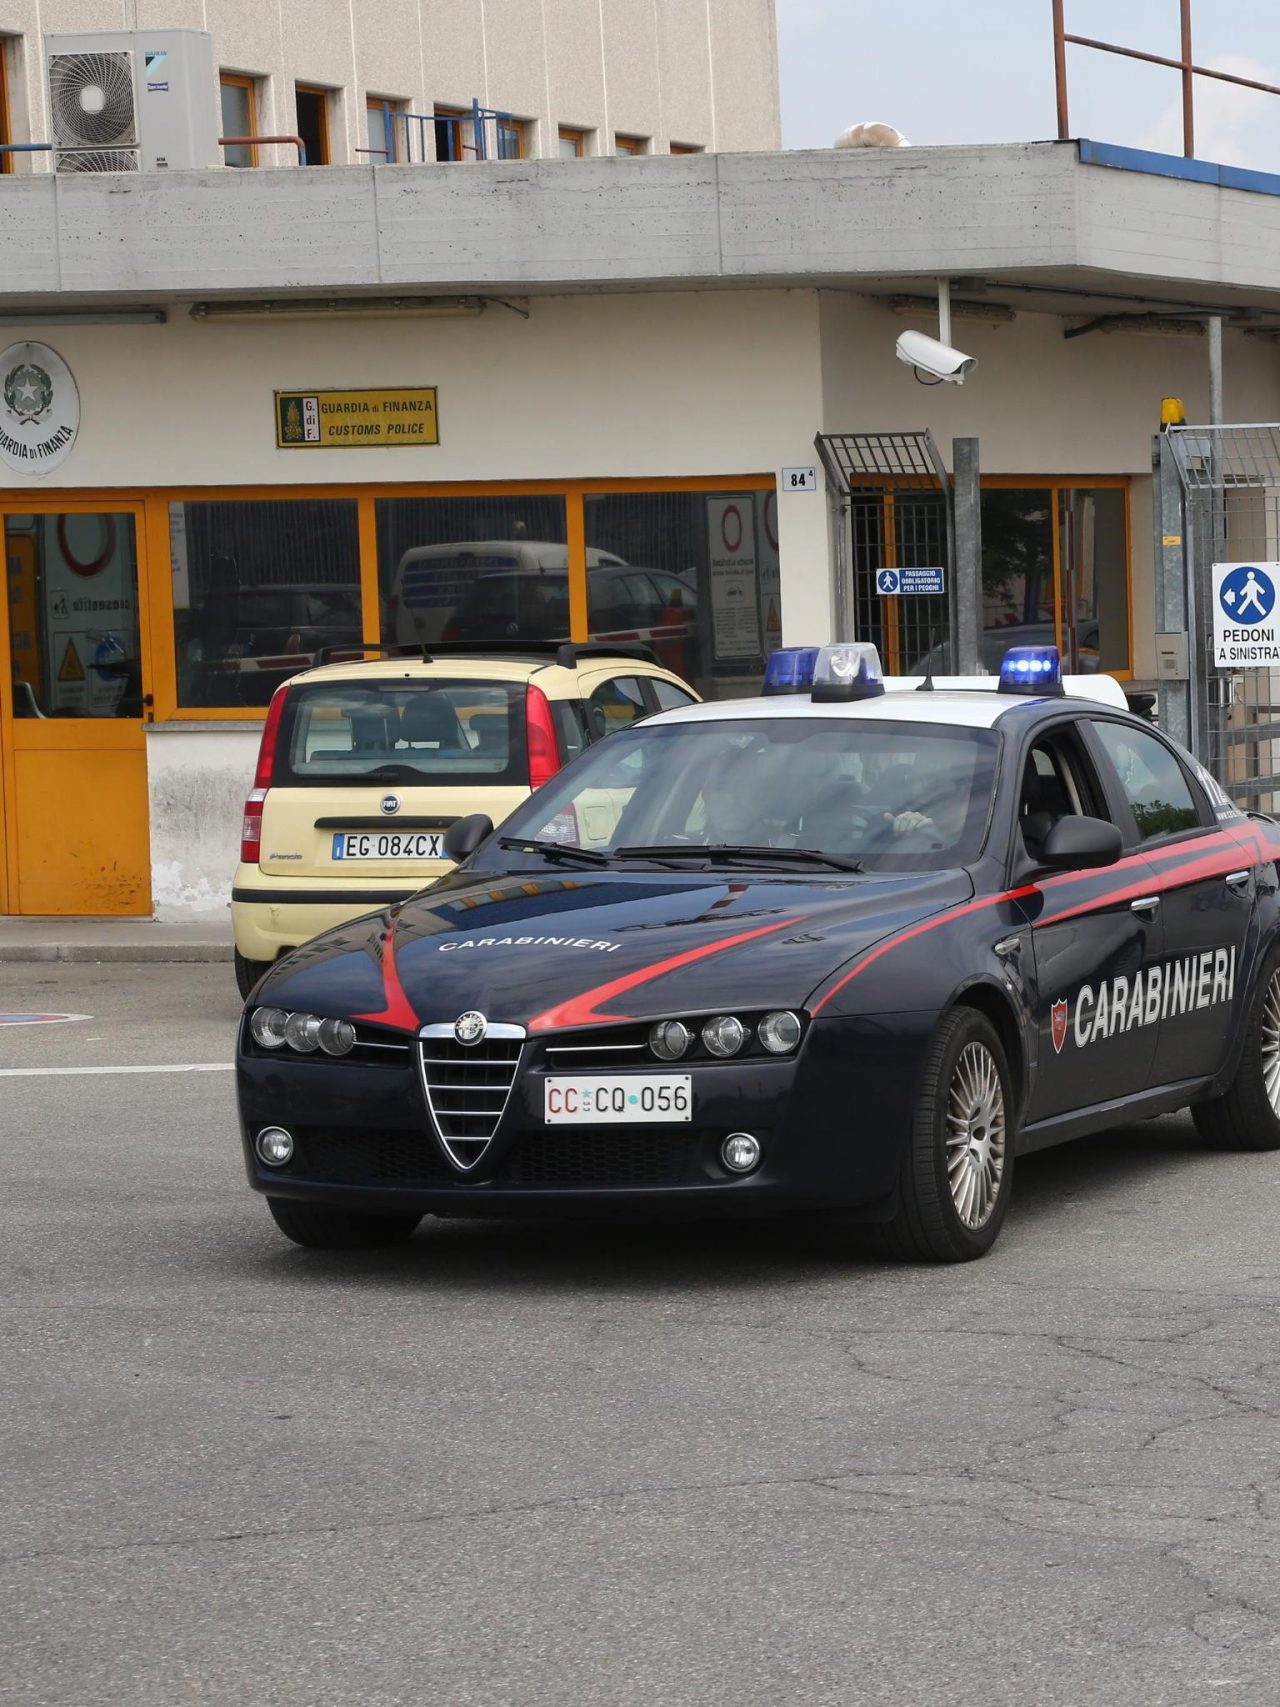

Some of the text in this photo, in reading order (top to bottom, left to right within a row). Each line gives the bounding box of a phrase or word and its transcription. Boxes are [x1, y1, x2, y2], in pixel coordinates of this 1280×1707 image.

[321, 403, 370, 414] GUARDIA
[383, 401, 432, 412] FINANZA
[306, 415, 316, 425] di
[328, 423, 425, 436] CUSTOMS POLICE
[29, 448, 38, 459] DI
[37, 425, 74, 458] FINANZA
[791, 473, 806, 487] 84
[901, 577, 940, 585] OBBLIGATORIO
[1223, 628, 1274, 642] PEDONI
[1219, 647, 1280, 661] A SINISTRA
[383, 800, 397, 808] FIAT
[346, 836, 370, 857] EG
[377, 835, 440, 857] 084CX
[438, 936, 623, 953] CARABINIERI
[1074, 945, 1236, 1048] CARABINIERI
[548, 1085, 688, 1114] CC CQ 056
